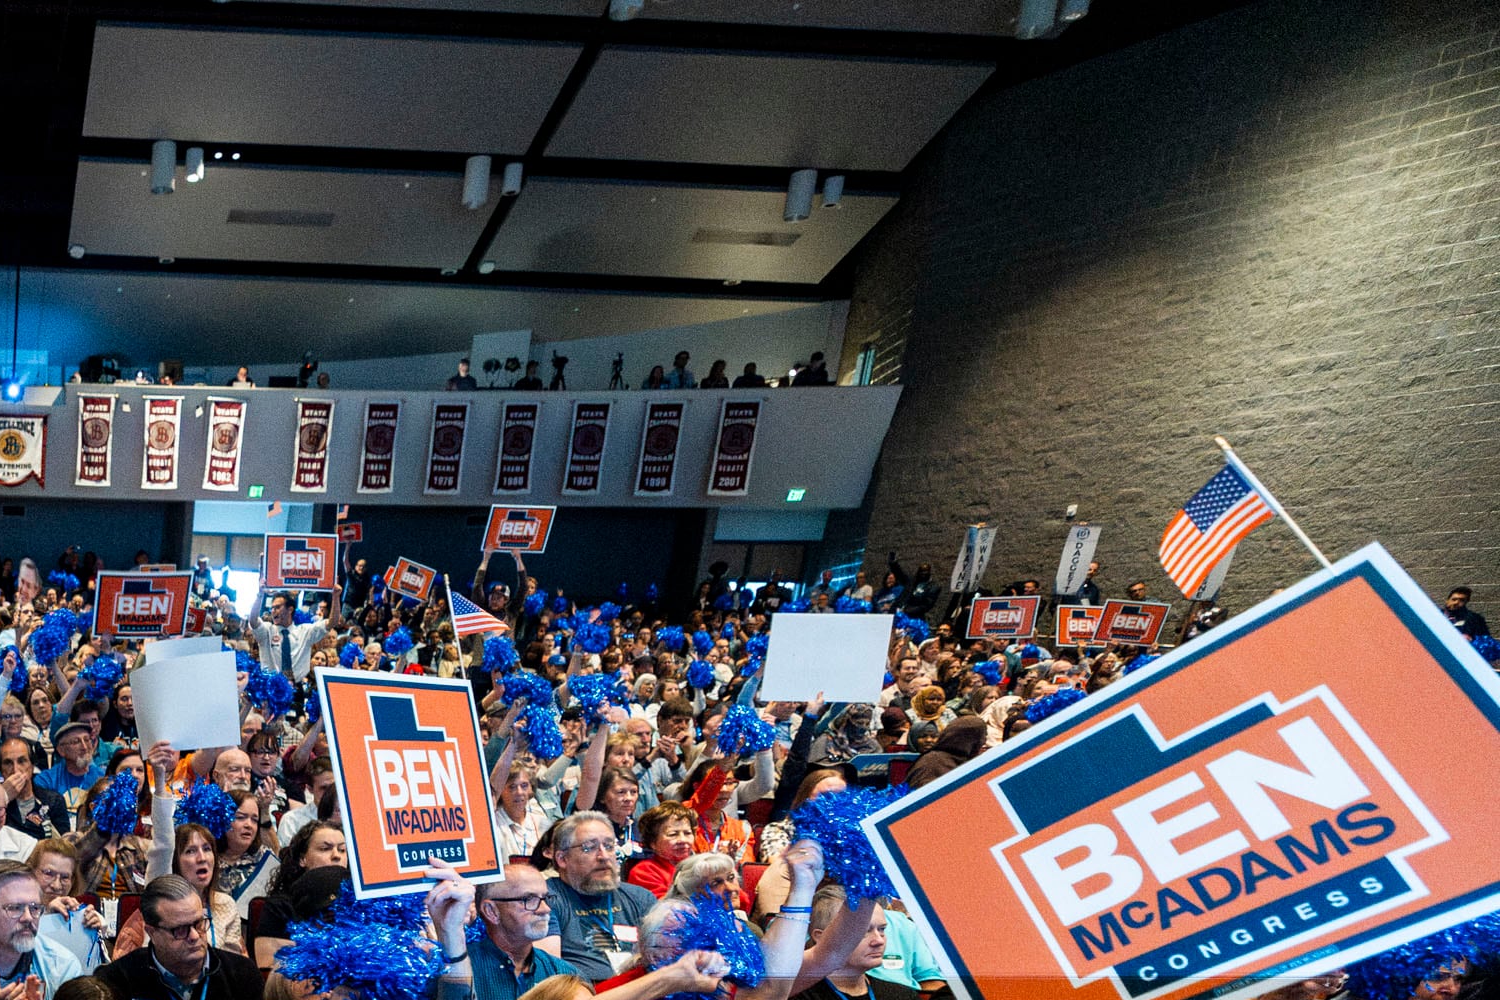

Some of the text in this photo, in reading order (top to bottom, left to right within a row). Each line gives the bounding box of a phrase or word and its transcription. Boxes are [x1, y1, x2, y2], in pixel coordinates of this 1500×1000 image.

[86, 404, 109, 412] STATE
[151, 406, 174, 414] STATE
[216, 408, 239, 416] STATE
[718, 477, 741, 488] 2001
[501, 521, 538, 536] BEN
[282, 553, 323, 571] BEN
[401, 571, 425, 587] BEN
[117, 595, 169, 615] BEN
[984, 611, 1022, 624] BEN
[1113, 615, 1150, 630] BEN
[1069, 620, 1097, 632] BEN
[373, 749, 463, 809] BEN
[386, 806, 467, 837] McADAMS
[1022, 715, 1371, 927] BEN
[403, 846, 463, 861] CONGRESS
[1068, 802, 1397, 962] McADAMS
[1137, 875, 1385, 982] CONGRESS
